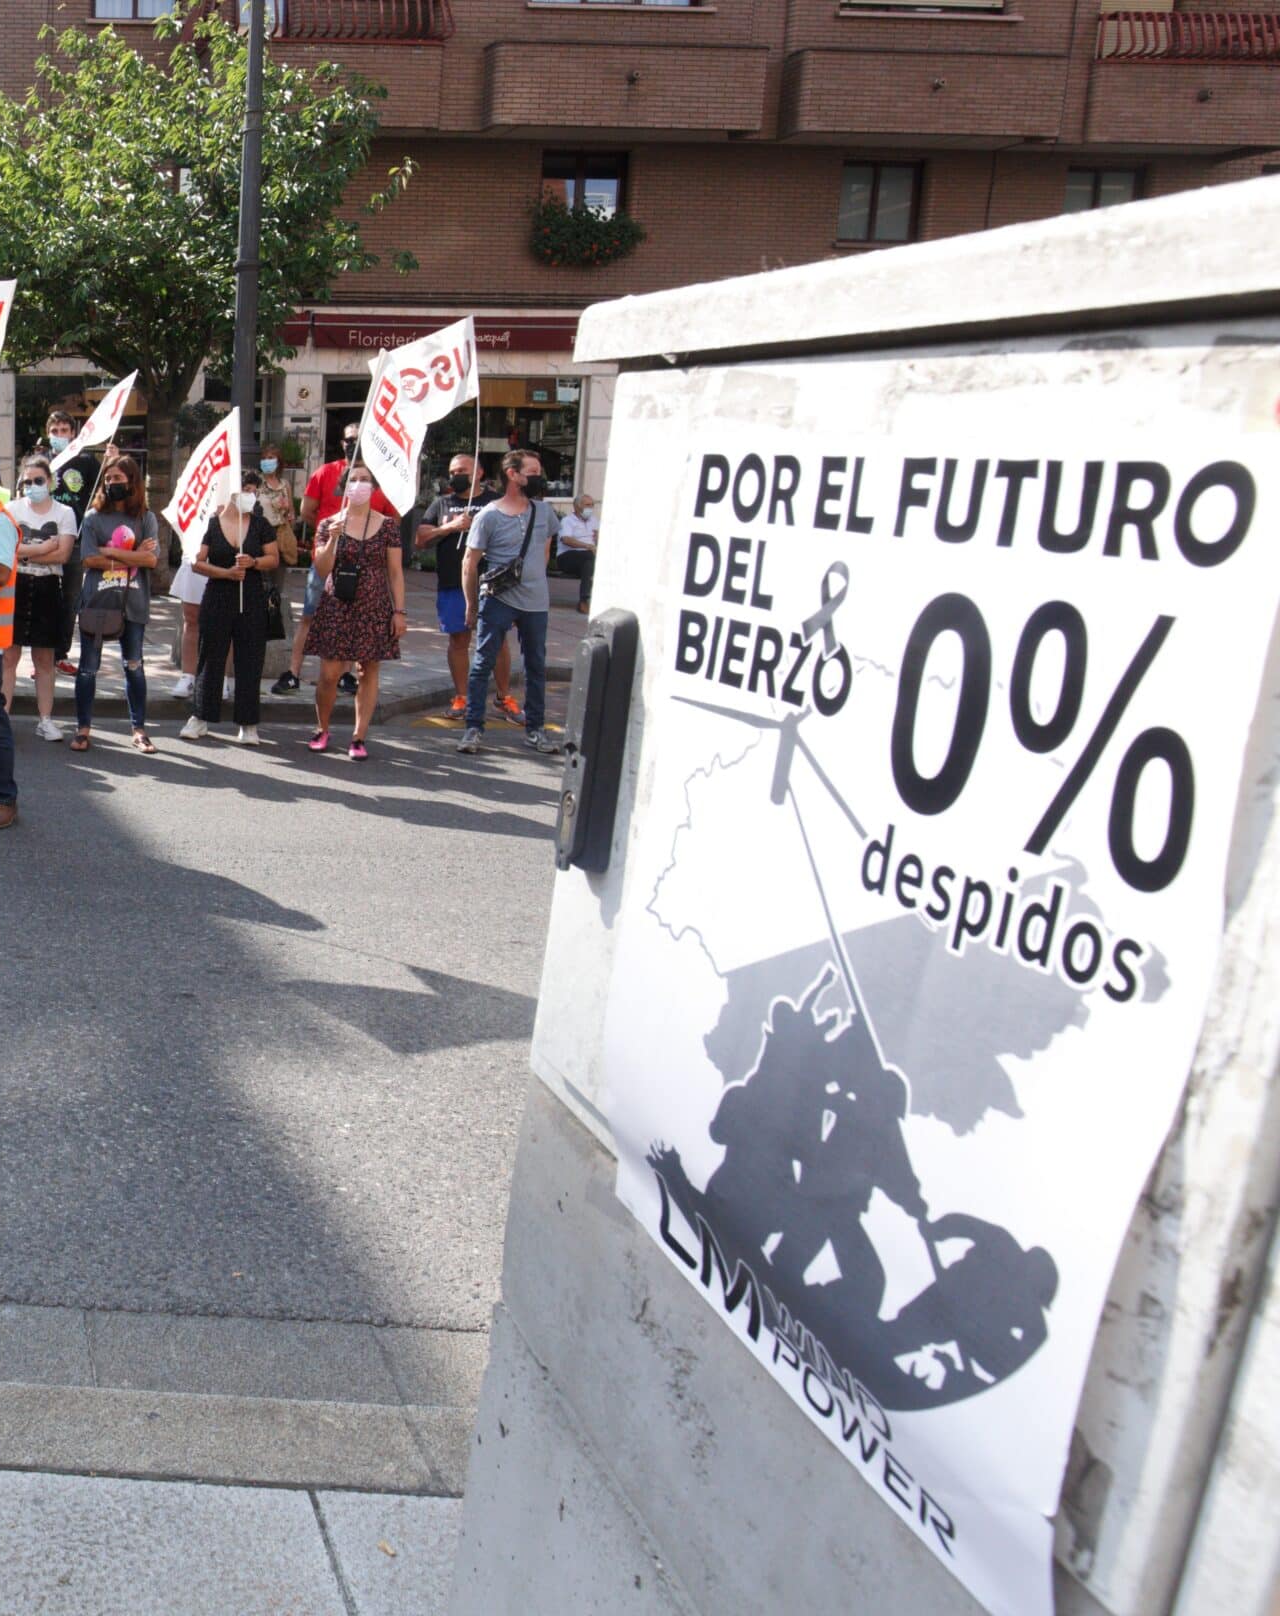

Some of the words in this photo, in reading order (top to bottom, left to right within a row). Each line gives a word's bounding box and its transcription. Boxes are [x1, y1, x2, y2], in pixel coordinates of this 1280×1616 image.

[682, 532, 774, 611] DEL
[693, 453, 802, 527] POR
[812, 455, 875, 535] EL
[893, 456, 1258, 569] FUTURO
[674, 609, 853, 717] BIERZO
[890, 592, 1195, 893] 0%
[860, 824, 1145, 1004] despidos
[773, 1329, 956, 1557] POWER
